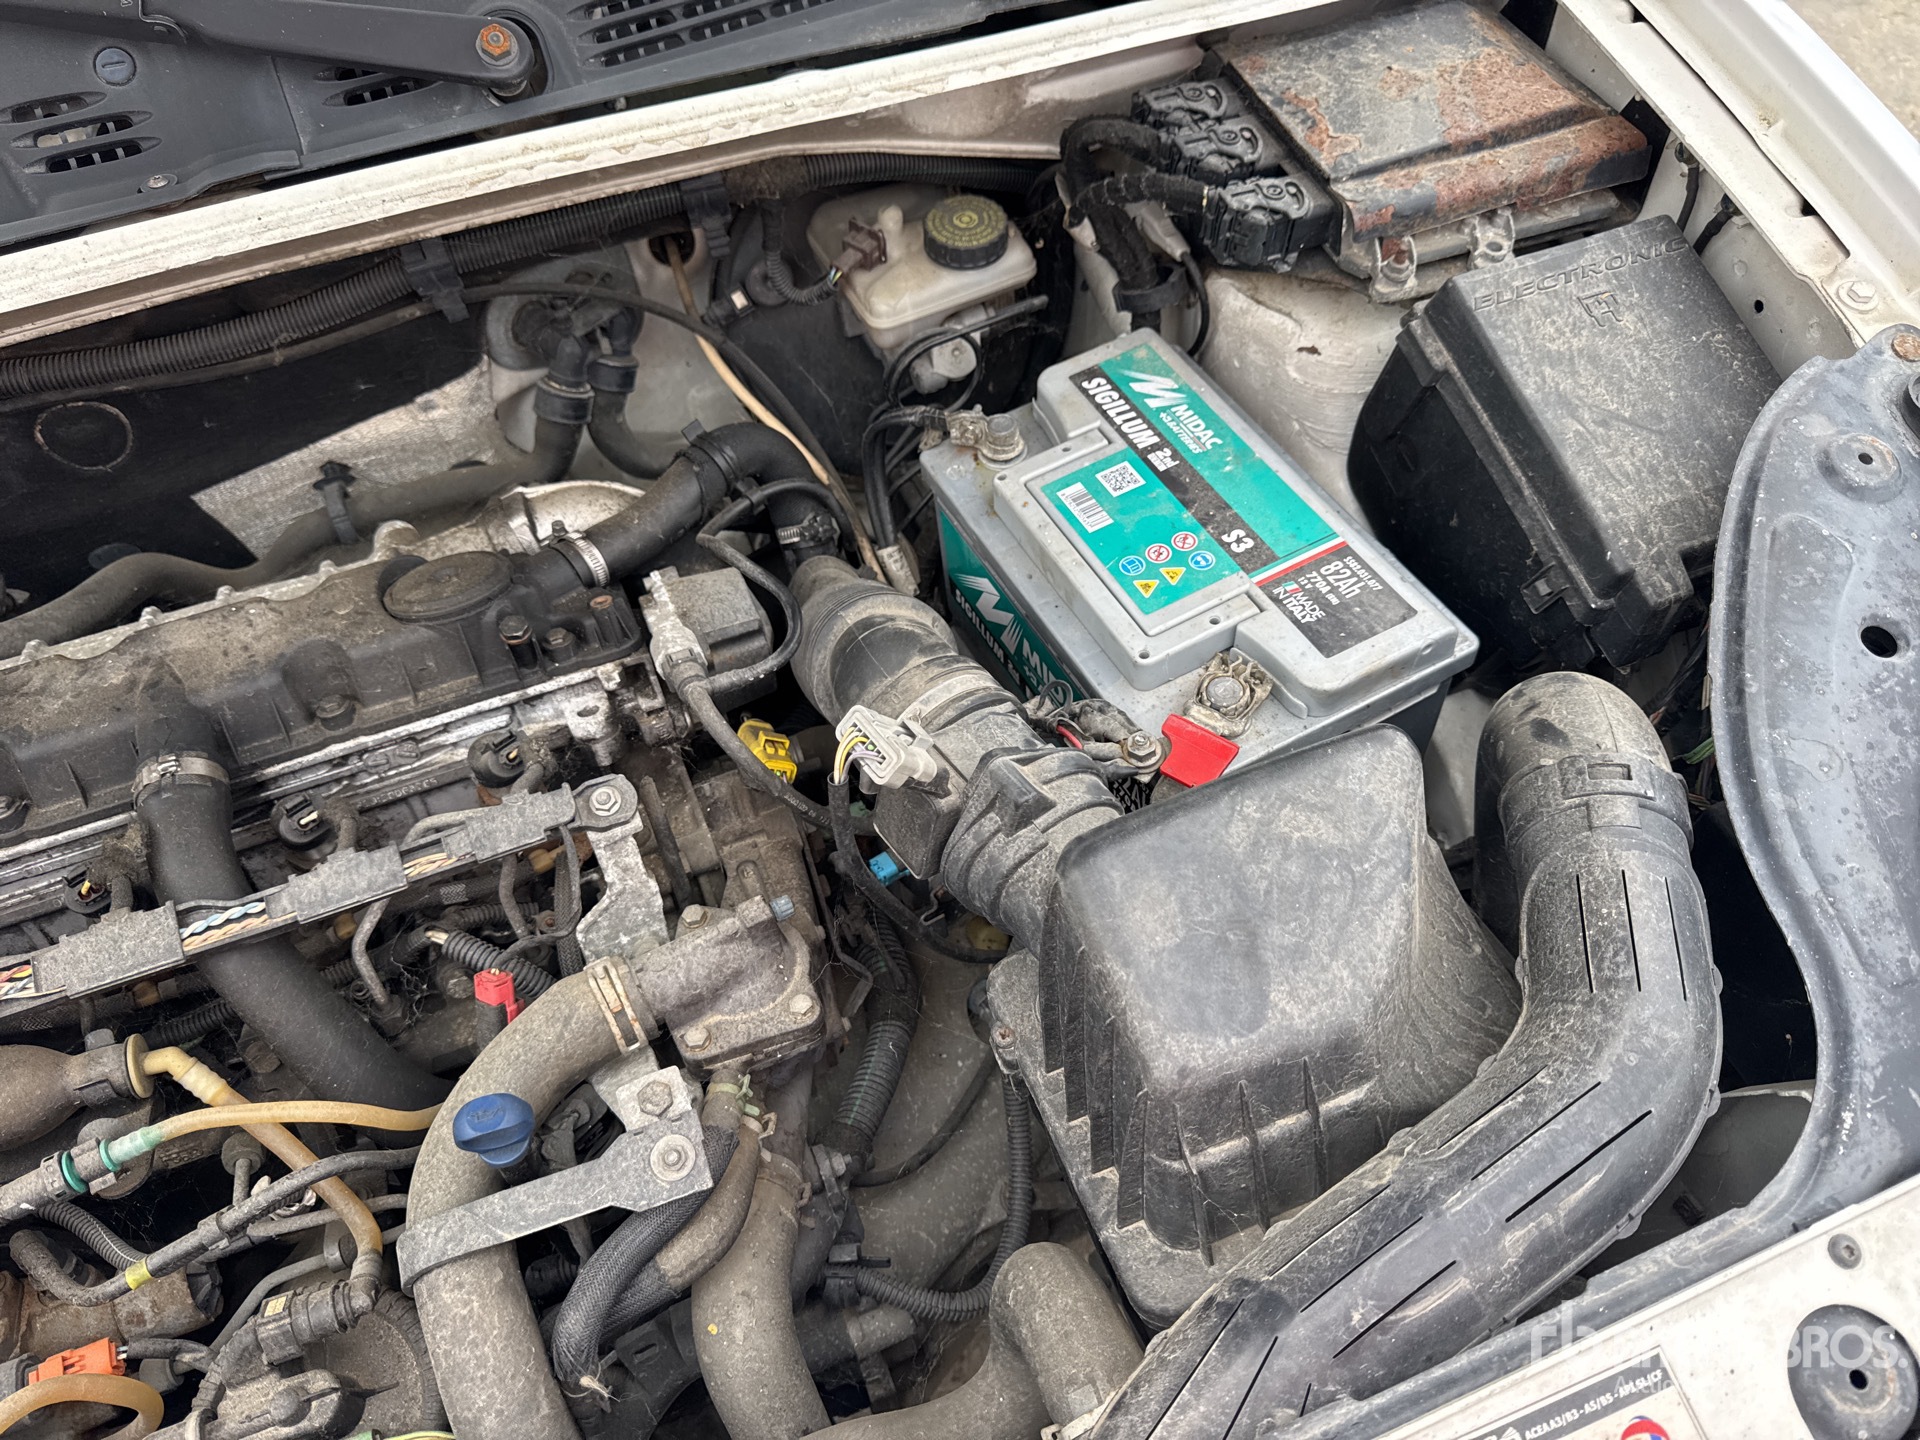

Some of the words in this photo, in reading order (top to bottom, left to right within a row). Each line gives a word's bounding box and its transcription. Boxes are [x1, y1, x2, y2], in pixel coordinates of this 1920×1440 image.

[1472, 237, 1688, 312] ELECTRONIC
[1171, 404, 1223, 449] MIDAC
[1082, 377, 1160, 449] SIGILLUM
[1221, 529, 1254, 553] S3
[1305, 570, 1331, 594] 770A
[1320, 561, 1366, 599] 82Ah
[1272, 586, 1290, 600] IN
[1283, 597, 1316, 623] ITALY
[1293, 592, 1326, 620] MADE
[955, 588, 1005, 664] SIGILLUM
